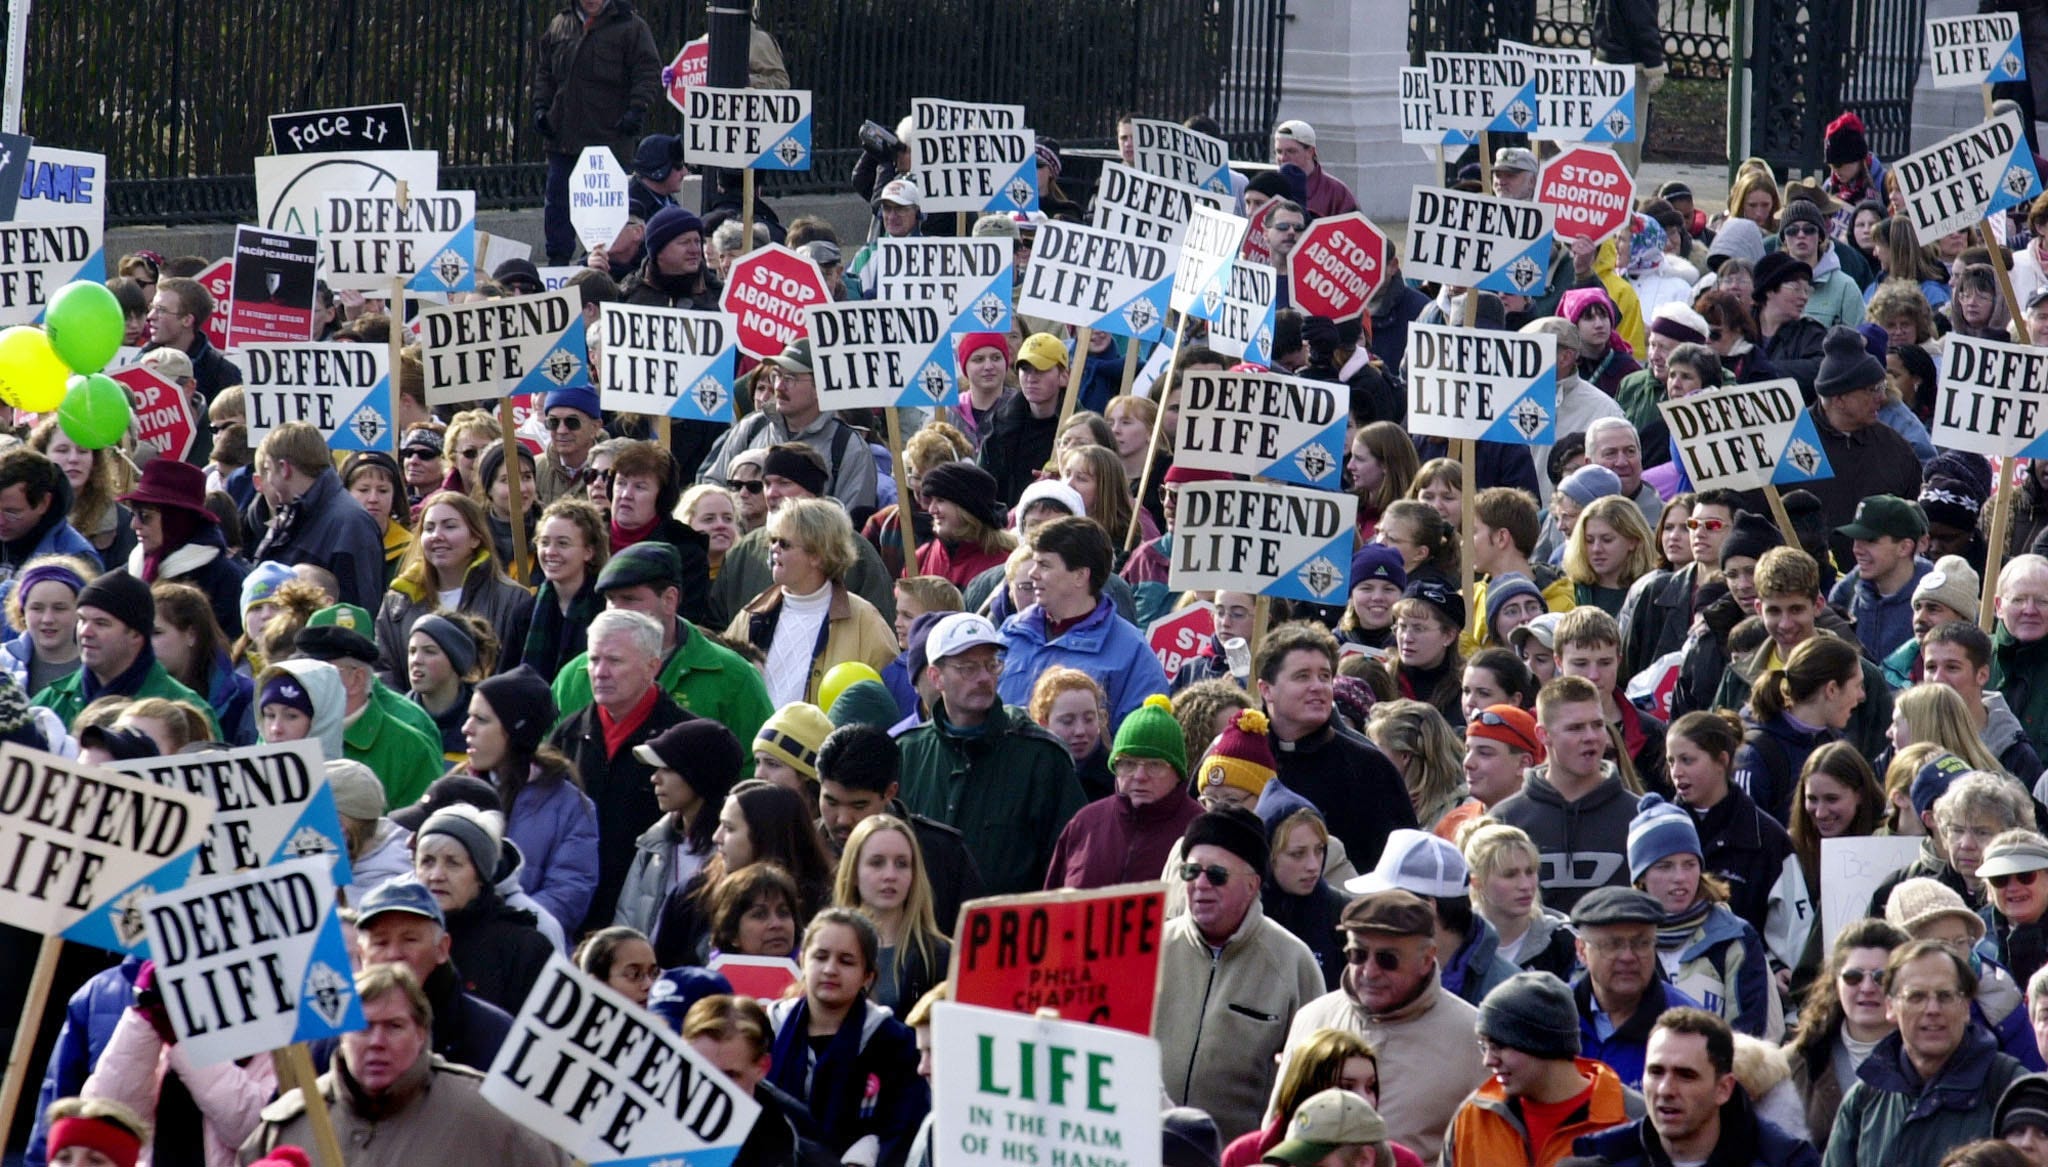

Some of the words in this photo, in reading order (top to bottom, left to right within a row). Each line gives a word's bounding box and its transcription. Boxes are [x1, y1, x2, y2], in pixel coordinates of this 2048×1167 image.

[1931, 17, 2013, 47] DEFEND
[675, 72, 707, 88] ABORT
[1431, 57, 1525, 87] DEFEND
[1934, 47, 1991, 76] LIFE
[1534, 68, 1626, 97] DEFEND
[690, 91, 800, 123] DEFEND
[1403, 103, 1432, 130] LIF
[1433, 88, 1495, 117] LIFE
[1536, 100, 1593, 127] LIFE
[288, 116, 351, 150] Face
[362, 116, 388, 143] It
[690, 123, 760, 154] LIFE
[918, 135, 1025, 165] DEFEND
[1137, 123, 1221, 167] DEFEND
[589, 155, 604, 170] WE
[1140, 152, 1199, 188] LIFE
[1561, 164, 1619, 188] STOP
[1900, 122, 2013, 195] DEFEND
[573, 191, 624, 208] PRO-LIFE
[583, 174, 610, 189] VOTE
[922, 168, 993, 198] LIFE
[1546, 182, 1625, 211] ABORTION
[1912, 171, 1989, 229] LIFE
[330, 197, 462, 233] DEFEND
[1415, 191, 1543, 240] DEFEND
[1557, 205, 1608, 227] NOW
[0, 226, 90, 265] FEND
[330, 239, 415, 274] LIFE
[883, 243, 1001, 277] DEFEND
[1038, 225, 1166, 282] DEFEND
[1328, 230, 1376, 272] STOP
[1410, 230, 1493, 273] LIFE
[753, 265, 815, 302] STOP
[1027, 264, 1113, 313] LIFE
[1303, 268, 1349, 310] NOW
[1304, 242, 1371, 301] ABORTION
[426, 296, 569, 349] DEFEND
[734, 282, 806, 327] ABORTIO
[607, 310, 723, 356] DEFEND
[743, 310, 798, 346] NOW
[812, 306, 938, 348] DEFEND
[246, 349, 377, 387] DEFEND
[430, 345, 523, 388] LIFE
[819, 352, 904, 391] LIFE
[1414, 330, 1542, 379] DEFEND
[1947, 341, 2048, 394] DEFE
[607, 354, 678, 397] LIFE
[136, 386, 160, 406] OP
[251, 393, 335, 430] LIFE
[1187, 377, 1335, 426] DEFEND
[1414, 375, 1493, 421] LIFE
[1667, 387, 1796, 440] DEFEND
[1940, 387, 2039, 439] LIFE
[138, 405, 182, 433] TION
[1182, 416, 1279, 459] LIFE
[1684, 432, 1774, 481] LIFE
[1183, 490, 1340, 538] DEFEND
[1179, 534, 1280, 577] LIFE
[1176, 627, 1212, 655] ST
[0, 756, 188, 858] DEFEND
[0, 831, 104, 911] IFE
[151, 872, 320, 968] DEFEND
[170, 953, 295, 1037] LIFE
[1029, 966, 1092, 986] PHILA
[1012, 985, 1107, 1011] CHAPTER
[533, 968, 733, 1144] DEFEND
[977, 1034, 1116, 1114] LIFE
[501, 1026, 646, 1155] LIFE
[969, 1105, 993, 1126] IN
[1006, 1112, 1046, 1137] THE
[1060, 1120, 1122, 1150] PALM
[961, 1133, 990, 1155] OF
[1002, 1141, 1039, 1165] HIS
